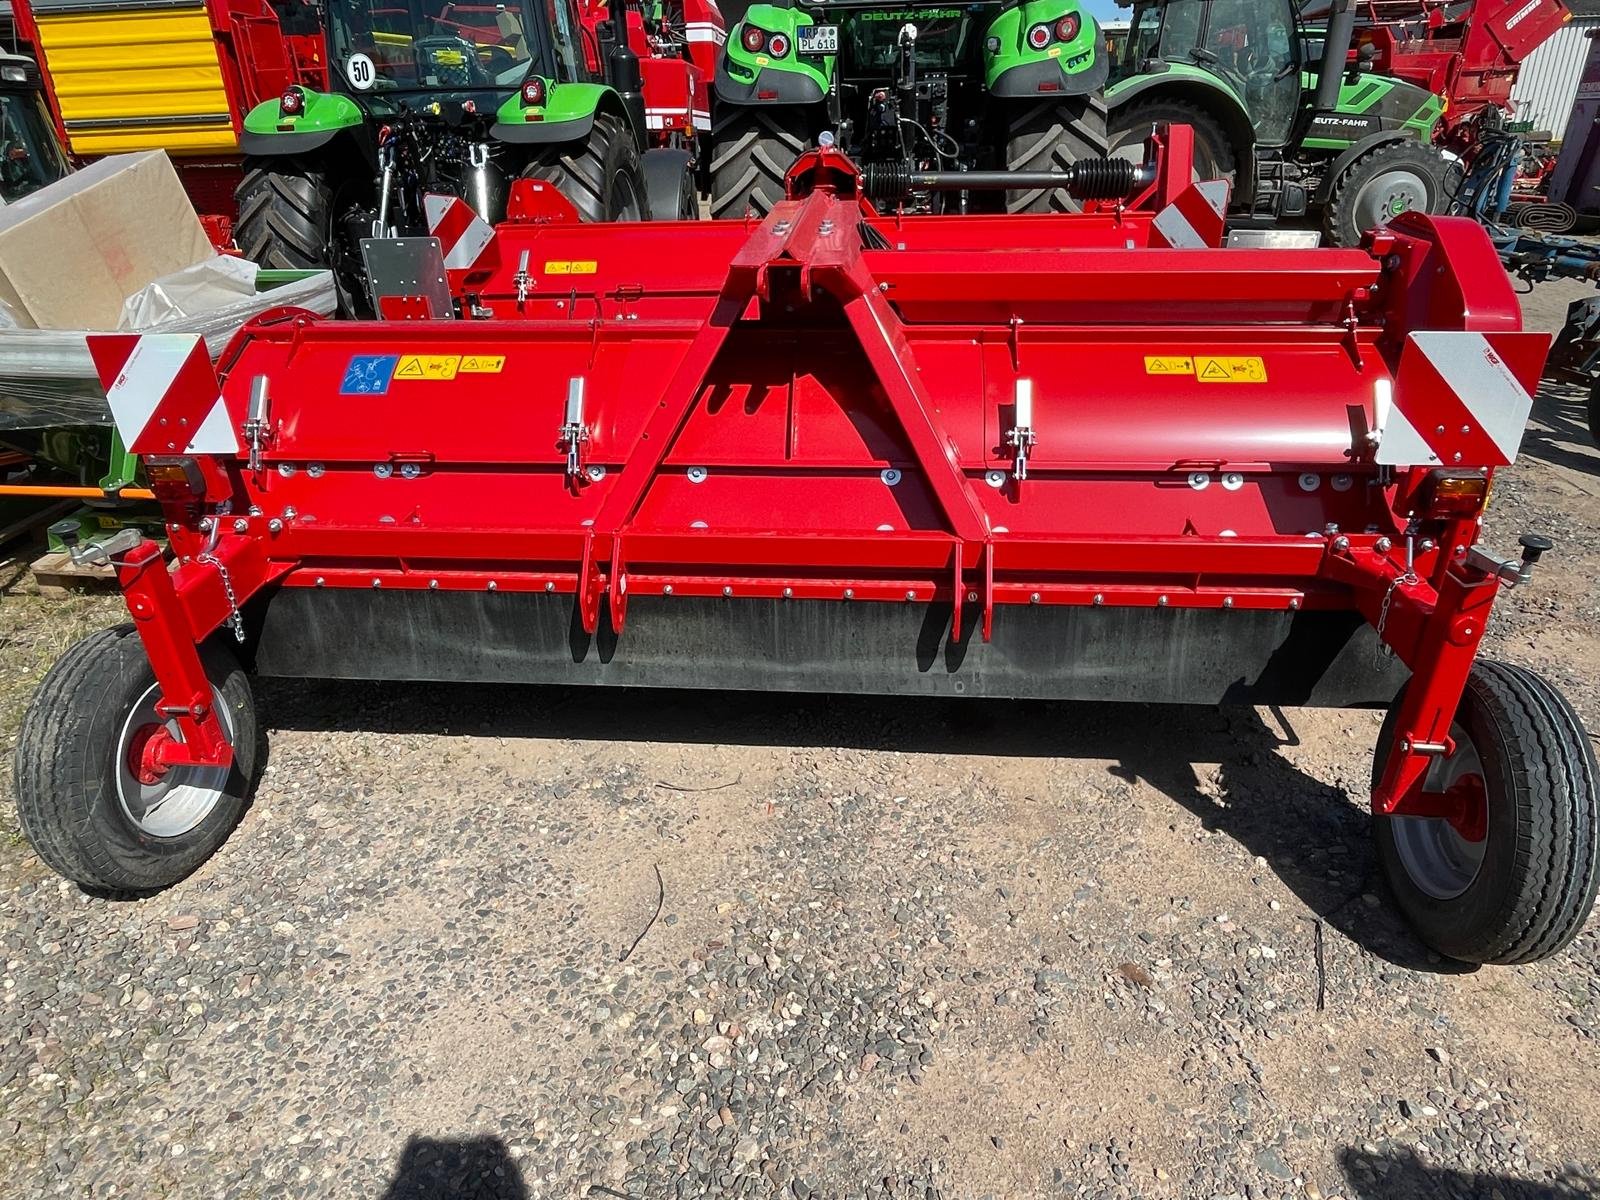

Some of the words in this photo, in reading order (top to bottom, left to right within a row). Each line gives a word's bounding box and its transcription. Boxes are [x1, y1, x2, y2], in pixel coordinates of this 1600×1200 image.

[861, 9, 961, 21] DEUTZ-FAHR
[802, 40, 814, 50] PL
[817, 39, 836, 50] 618
[352, 60, 370, 82] 50
[1313, 117, 1369, 127] EUTZ-FAHR
